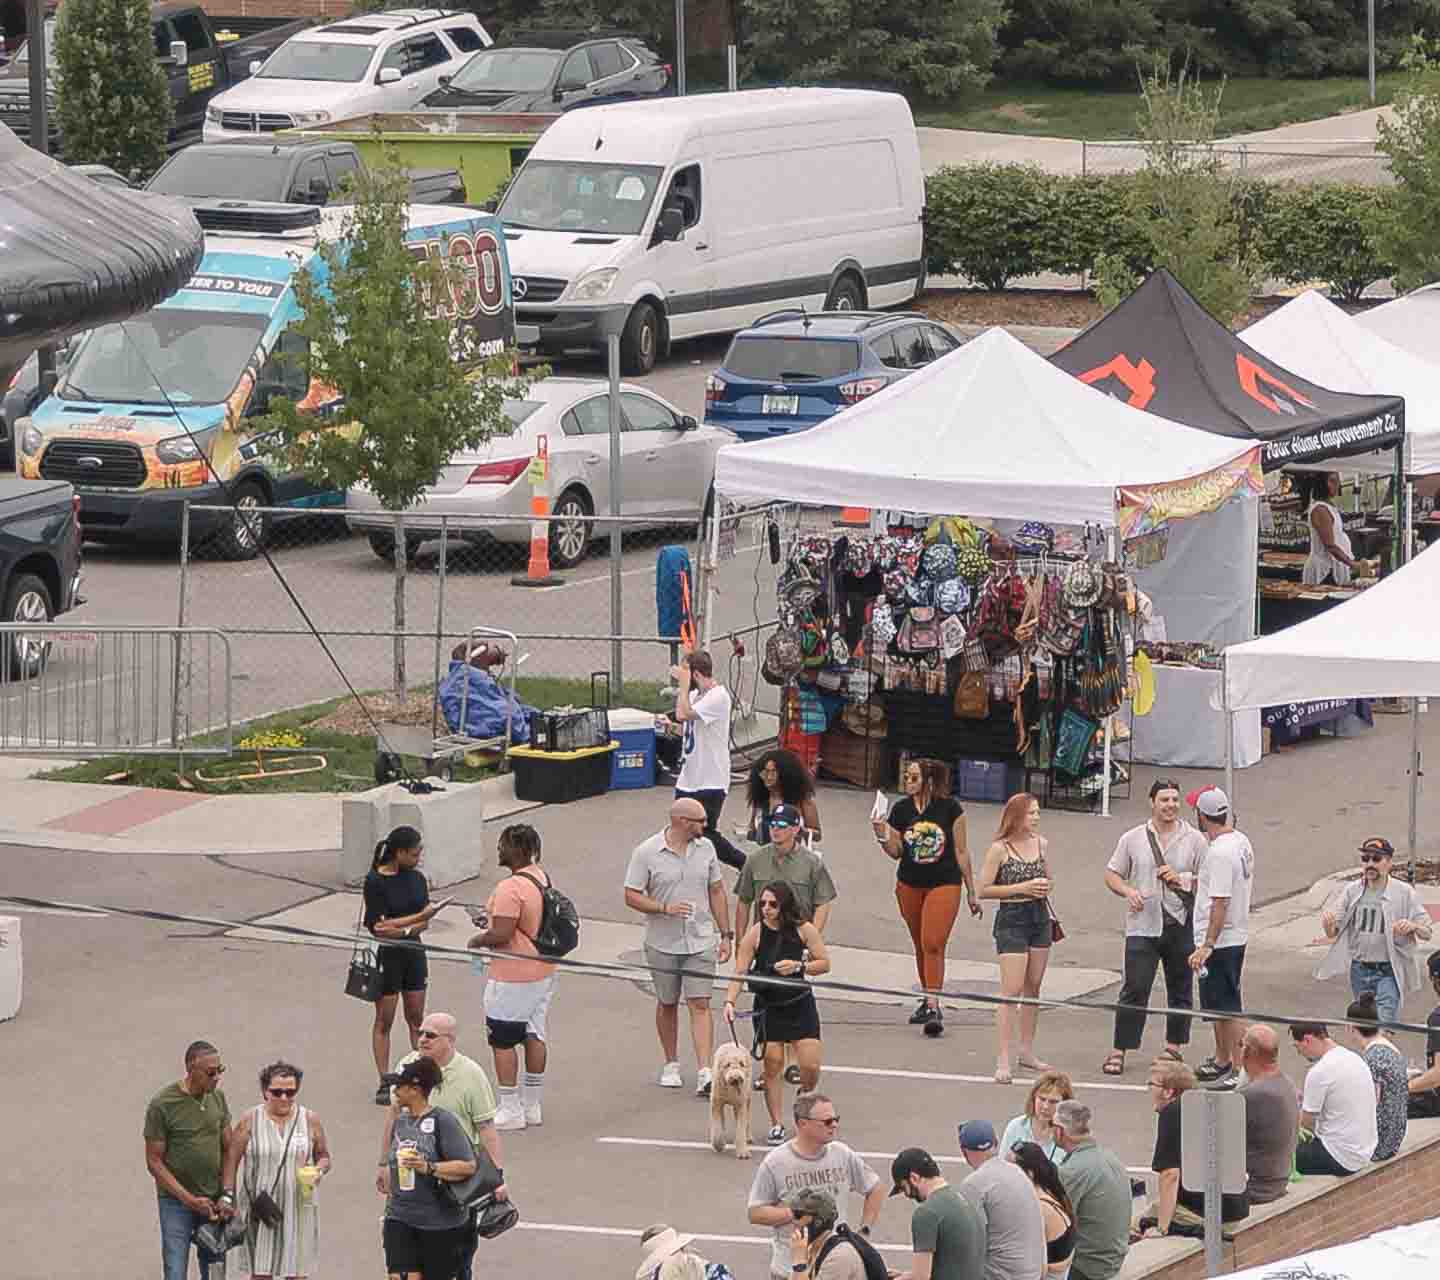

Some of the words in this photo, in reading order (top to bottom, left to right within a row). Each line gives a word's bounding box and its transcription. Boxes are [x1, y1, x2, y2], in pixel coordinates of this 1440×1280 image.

[215, 278, 233, 291] TO
[1291, 433, 1322, 455] Home
[1320, 416, 1385, 450] Improvement
